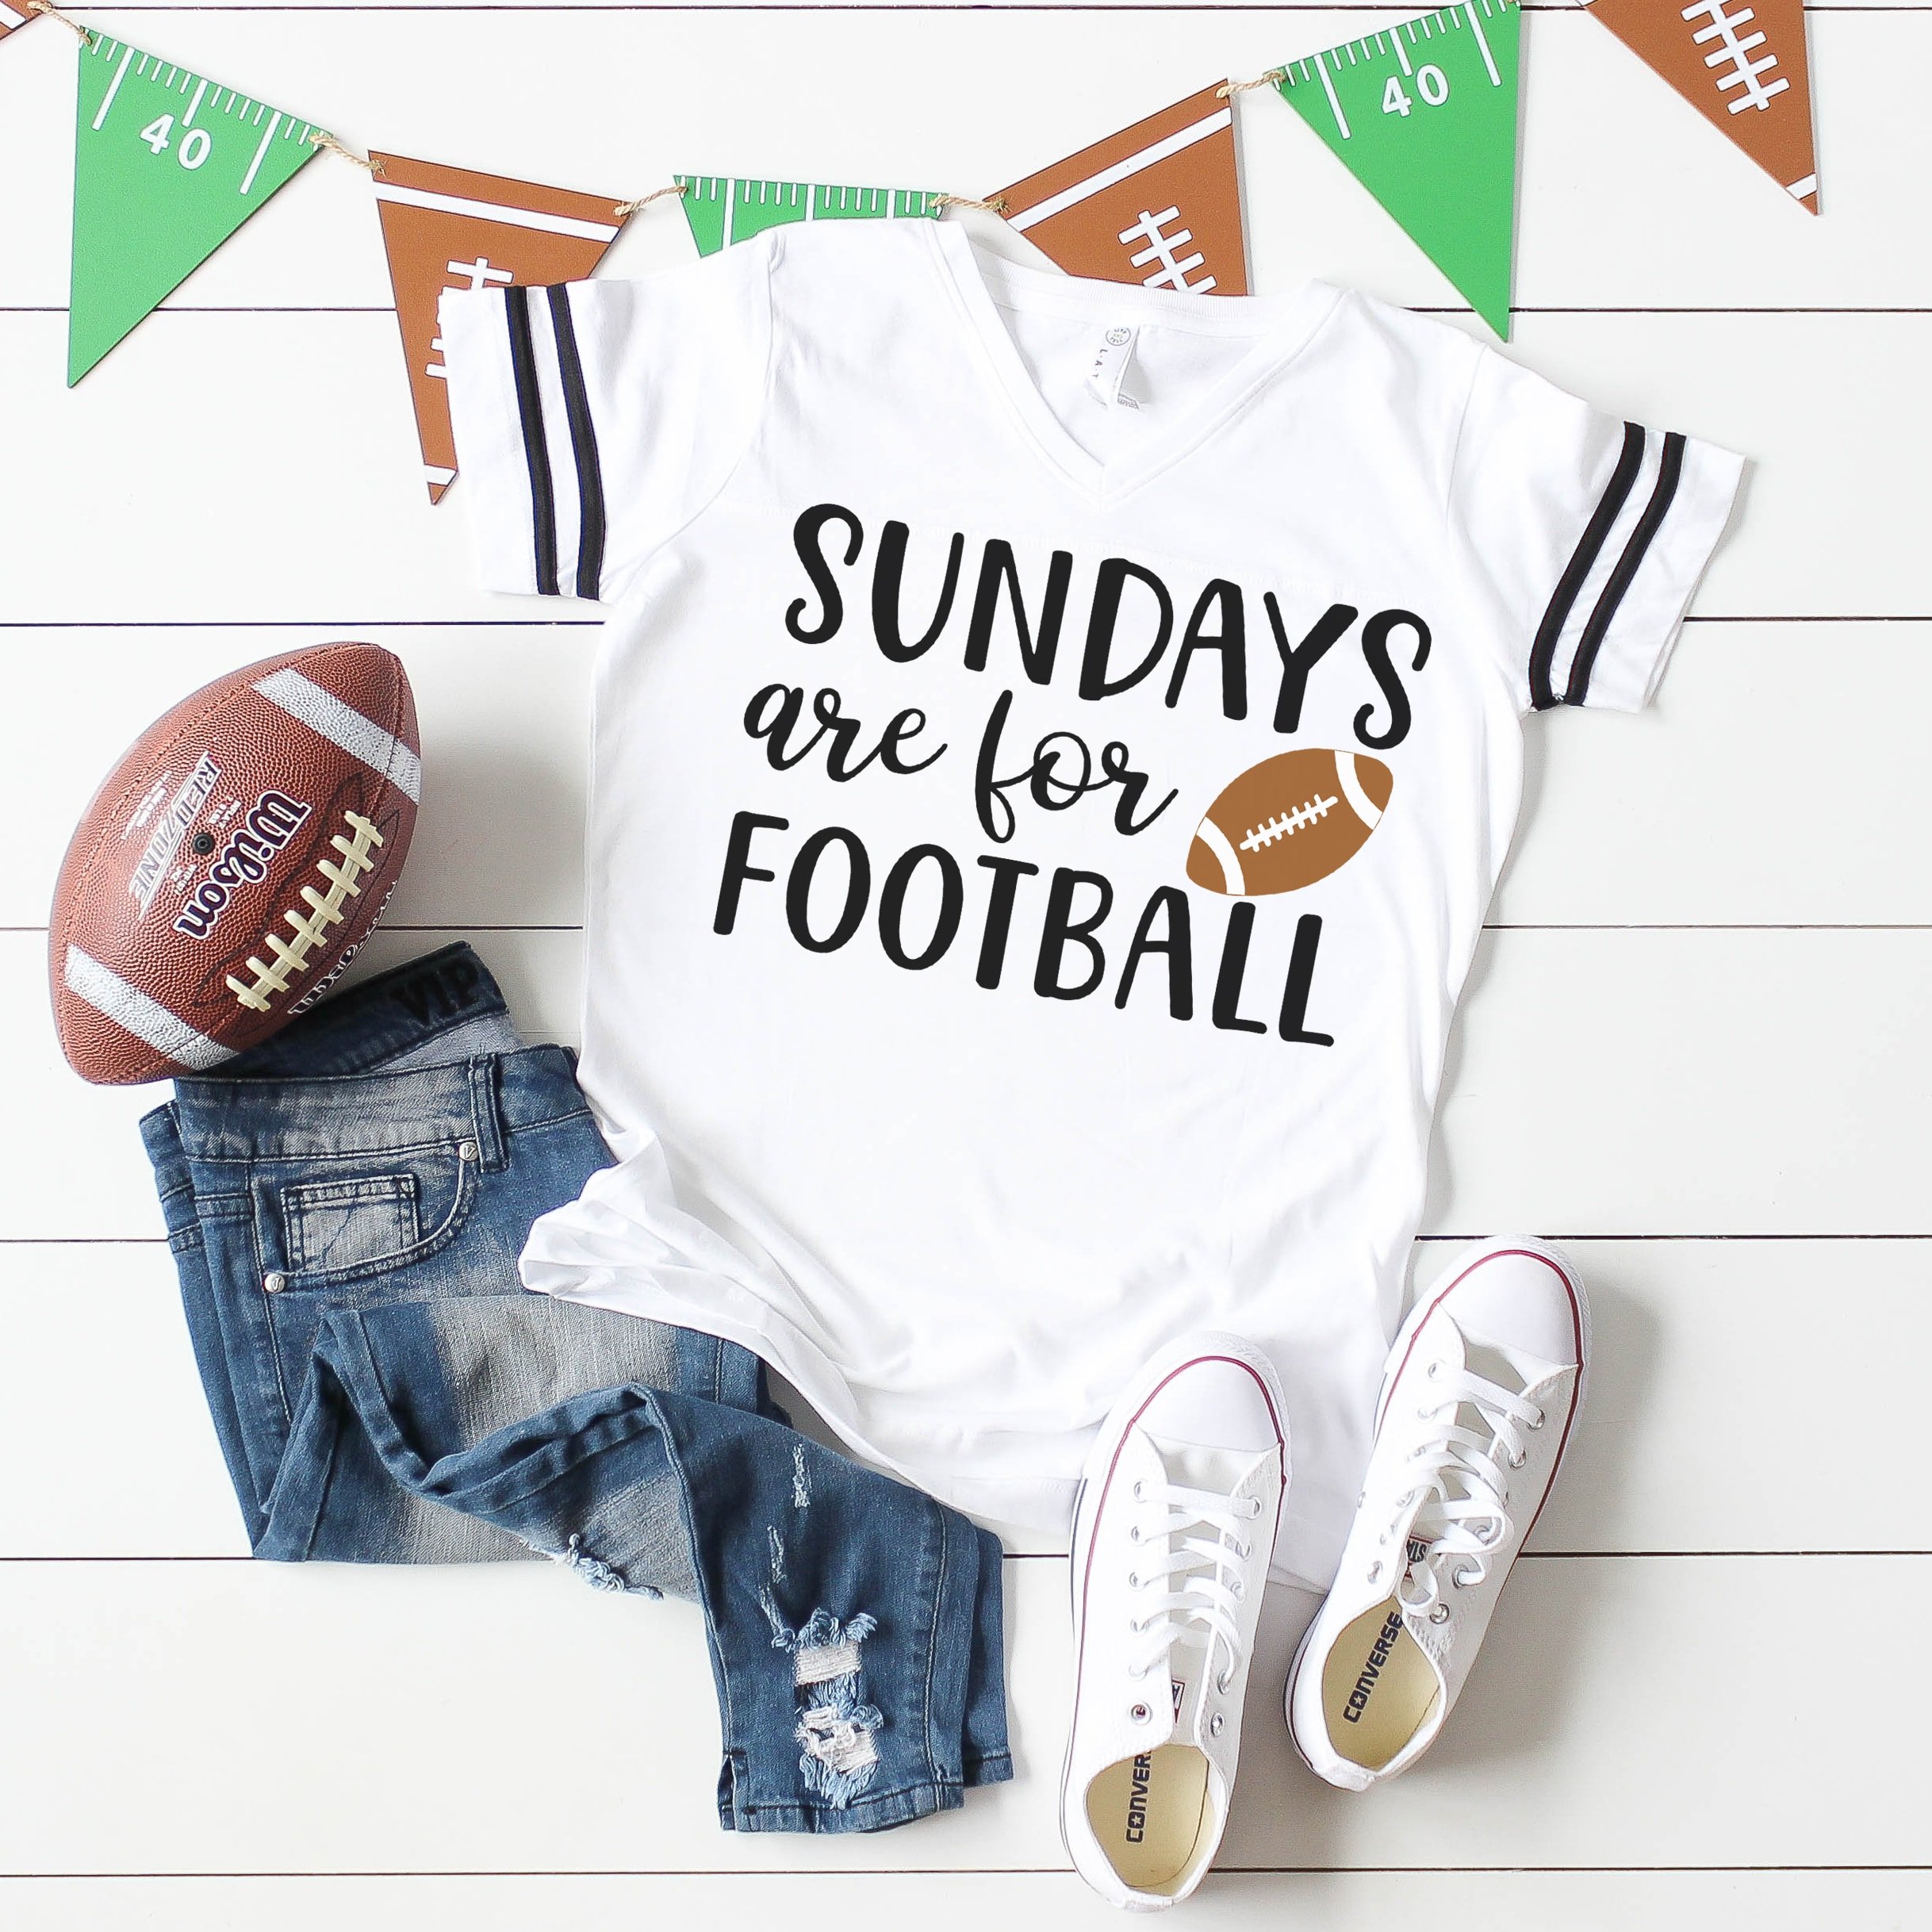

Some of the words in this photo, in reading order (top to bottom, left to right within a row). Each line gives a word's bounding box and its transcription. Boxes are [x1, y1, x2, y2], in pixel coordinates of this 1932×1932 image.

[140, 113, 213, 171] 40
[1381, 63, 1450, 118] 40
[786, 504, 1432, 749] SUNDAYS
[744, 684, 947, 782] are
[976, 690, 1178, 843] for
[172, 790, 312, 940] Wilson
[714, 811, 1334, 1046] FOOTBALL
[390, 957, 479, 1028] VIP
[1344, 1611, 1403, 1723] CONVERSE
[1126, 1750, 1152, 1842] CONVER
